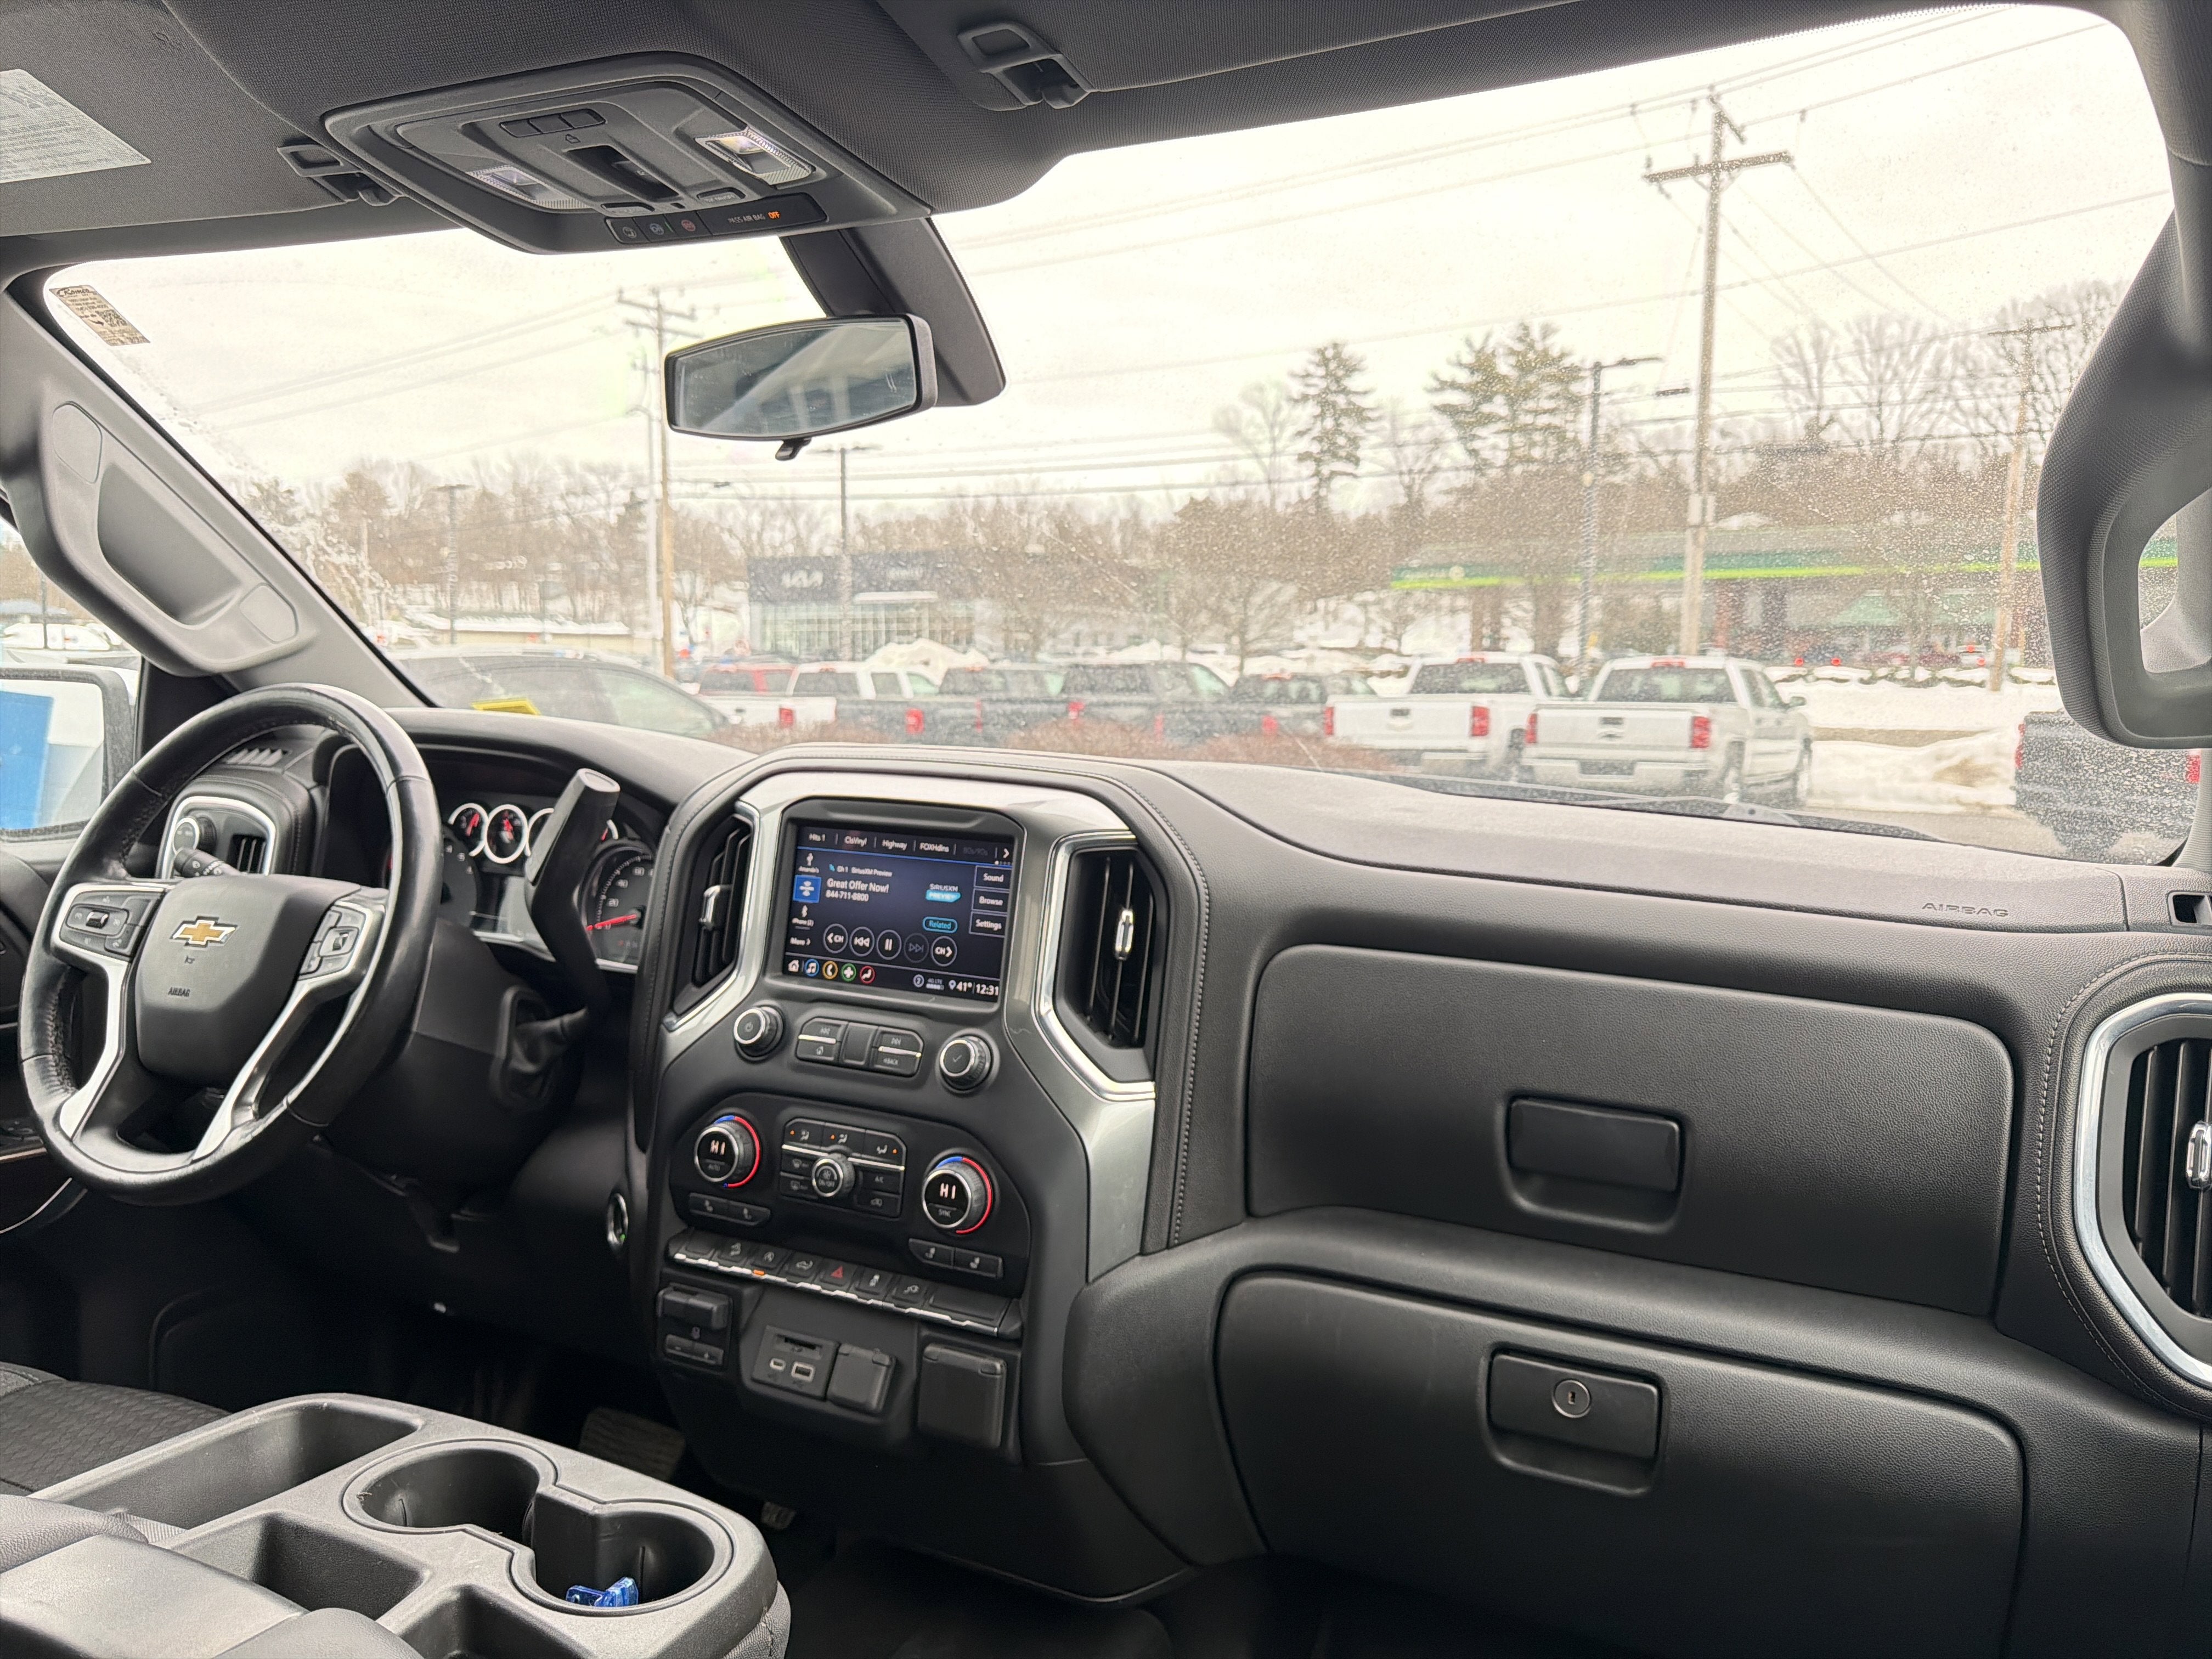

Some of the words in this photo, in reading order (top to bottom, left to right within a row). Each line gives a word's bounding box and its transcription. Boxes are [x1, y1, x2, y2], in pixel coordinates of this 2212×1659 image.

[768, 211, 780, 219] OFF
[882, 839, 907, 850] Highway
[983, 873, 1004, 883] Sound
[827, 878, 848, 889] Great
[849, 879, 868, 891] Offer
[868, 882, 889, 893] Now!
[979, 895, 1003, 906] Browse
[1921, 902, 2008, 917] AIRBAG
[929, 920, 952, 929] Related
[975, 918, 1002, 931] Settings
[790, 936, 805, 946] More
[833, 934, 844, 943] CH
[935, 946, 945, 955] CH
[167, 986, 190, 997] AIRBAG
[956, 981, 972, 992] 41°
[975, 983, 999, 996] 12:31
[710, 1139, 725, 1155] HI
[940, 1183, 956, 1199] HI
[938, 1209, 952, 1218] SYNC
